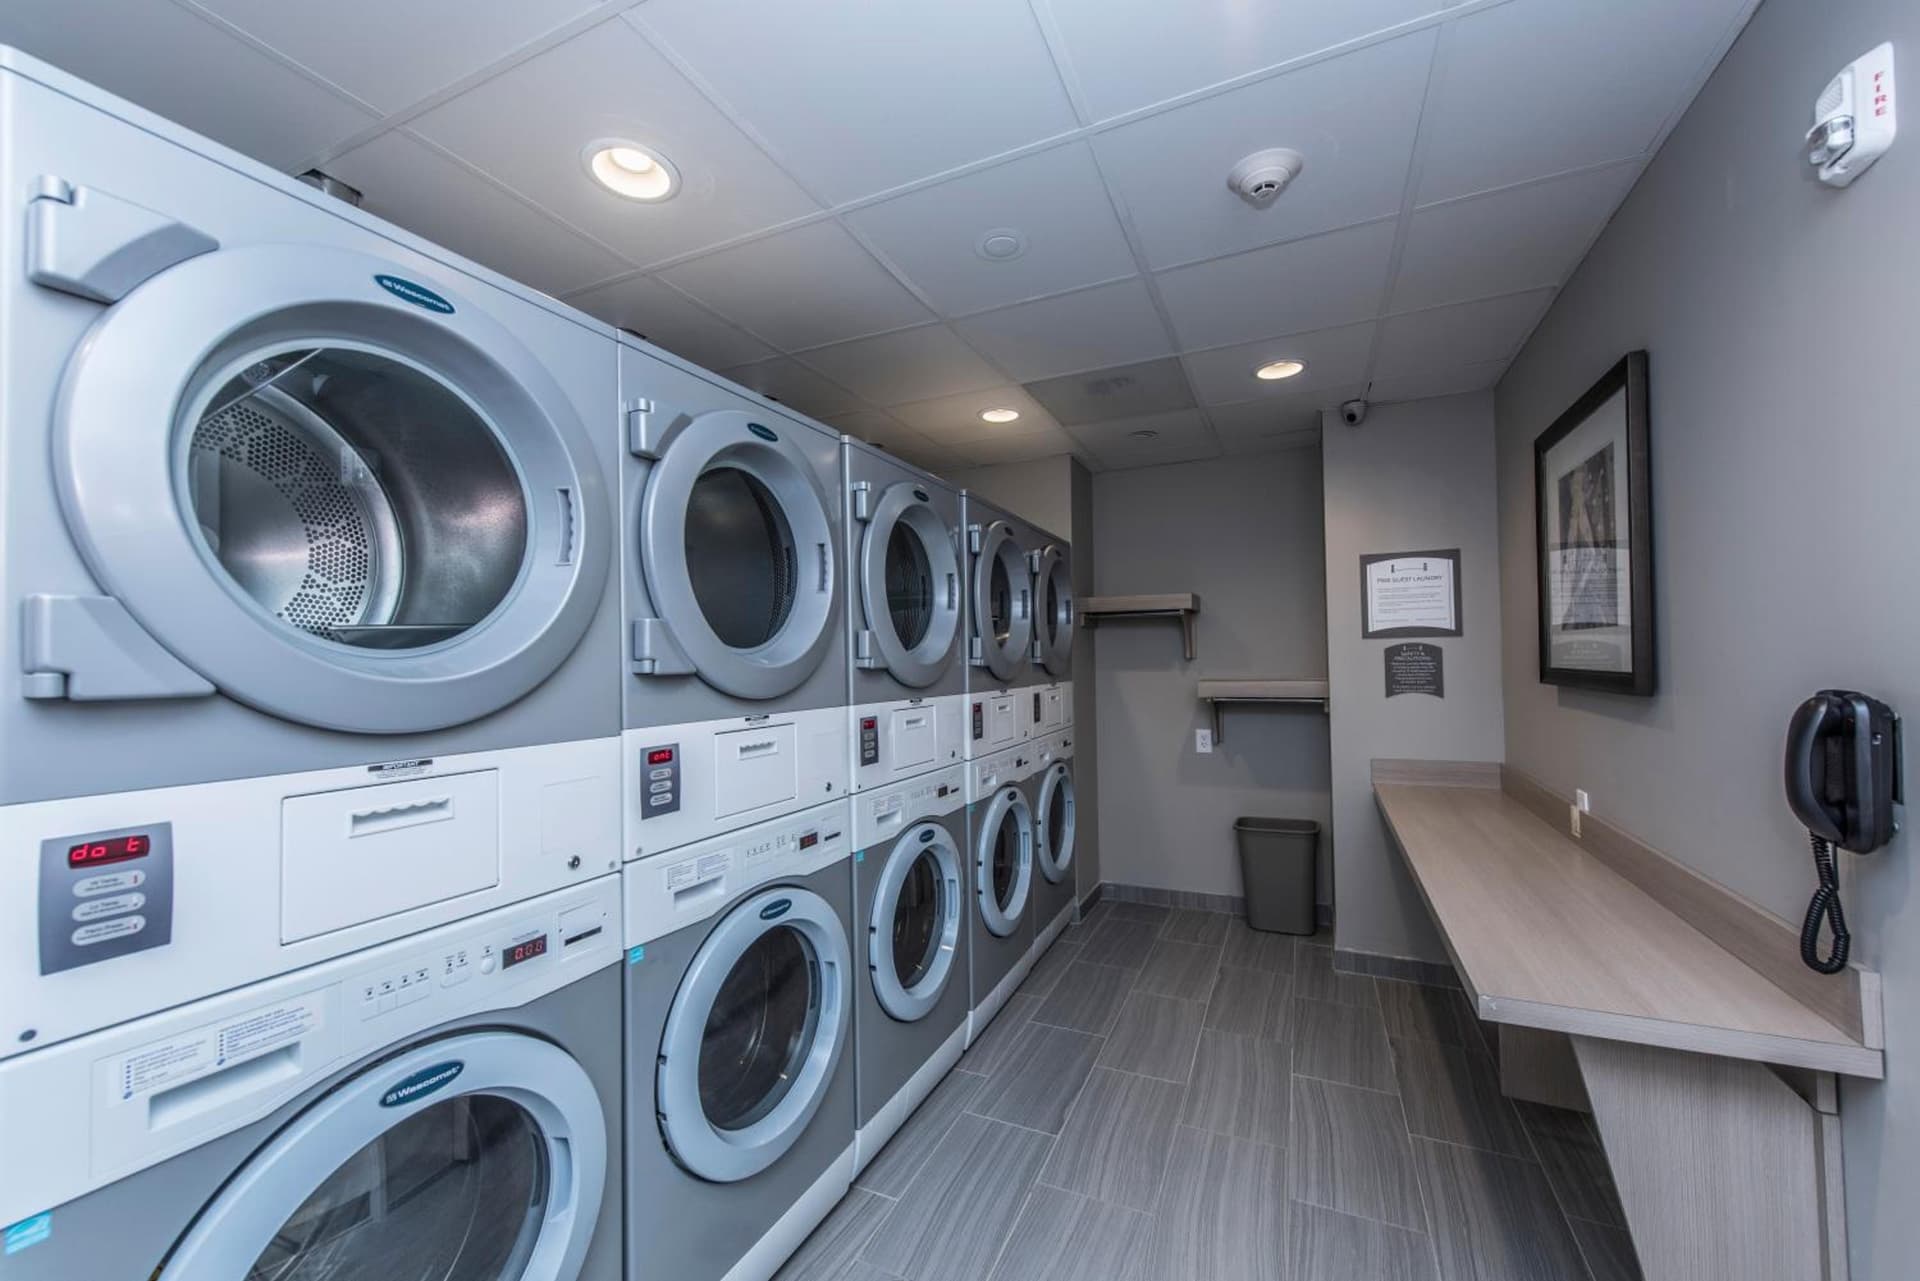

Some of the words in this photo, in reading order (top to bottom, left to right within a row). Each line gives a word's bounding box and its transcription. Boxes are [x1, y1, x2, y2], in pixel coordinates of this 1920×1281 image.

[1874, 70, 1888, 117] FIRE
[1413, 575, 1442, 583] LAUNDRY
[398, 1065, 458, 1098] Wascomat
